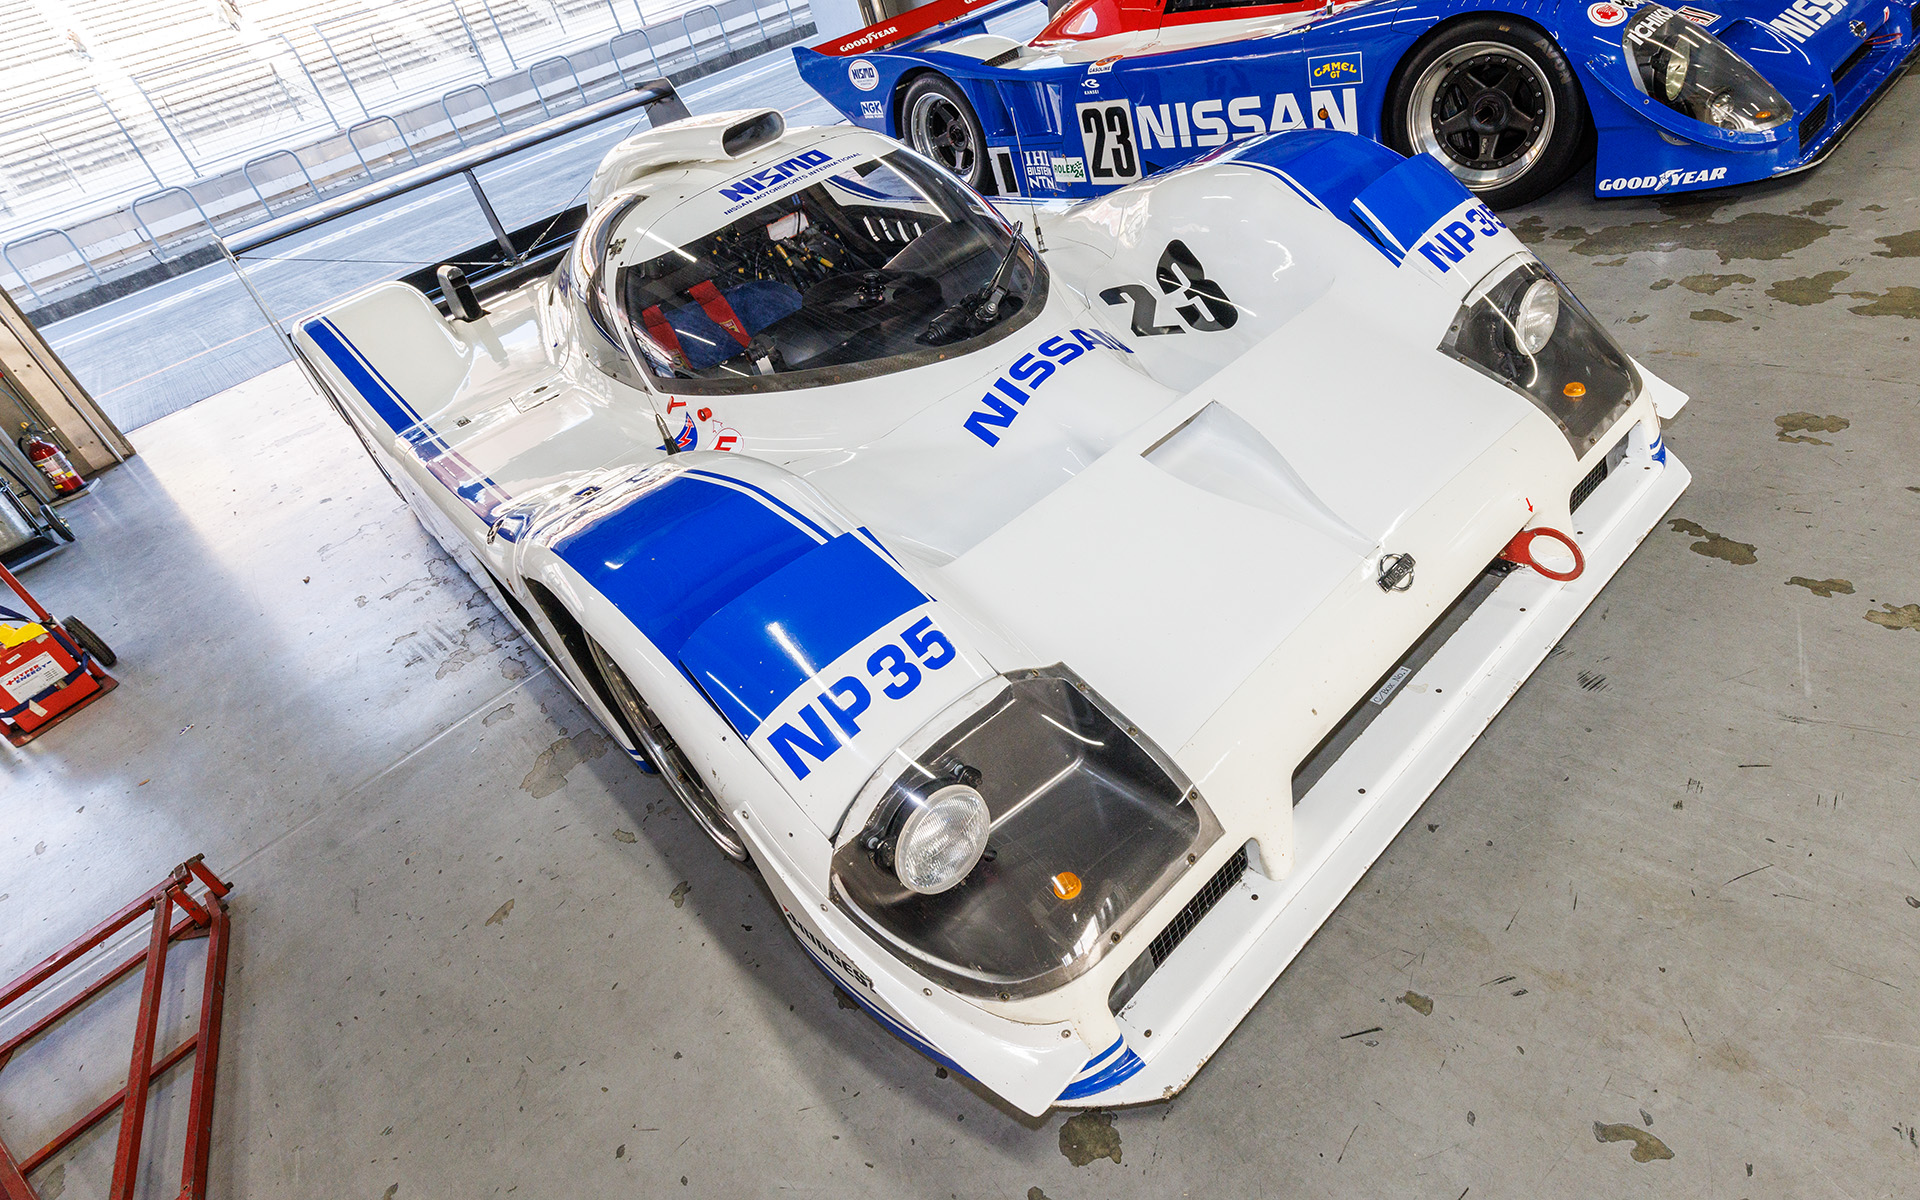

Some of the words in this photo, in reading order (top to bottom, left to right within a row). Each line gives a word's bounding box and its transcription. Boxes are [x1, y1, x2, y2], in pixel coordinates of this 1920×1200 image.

[1769, 0, 1849, 43] NISS
[851, 67, 875, 80] NISMO
[1089, 65, 1111, 73] GASOLINE
[1313, 62, 1357, 77] CAMEL
[1330, 70, 1341, 79] GT
[861, 102, 883, 114] NGK
[1136, 88, 1359, 150] NISSAN
[1024, 150, 1050, 166] IHI
[1081, 106, 1137, 178] 23
[718, 149, 833, 203] NISMO
[724, 199, 752, 216] NISSAN
[753, 175, 808, 201] MOTORSPORTS
[807, 152, 863, 177] INTERNATIONAL
[1028, 176, 1055, 190] NTN
[1054, 164, 1075, 174] ROLEX
[1074, 169, 1084, 178] 24
[1418, 203, 1508, 273] NP35
[1099, 239, 1239, 337] 23
[963, 328, 1135, 448] NISSAN
[1384, 557, 1414, 588] NISSAN
[13, 664, 39, 681] HYPER
[1373, 683, 1396, 703] C/Box
[1392, 667, 1409, 682] No.1
[767, 615, 957, 781] NP35
